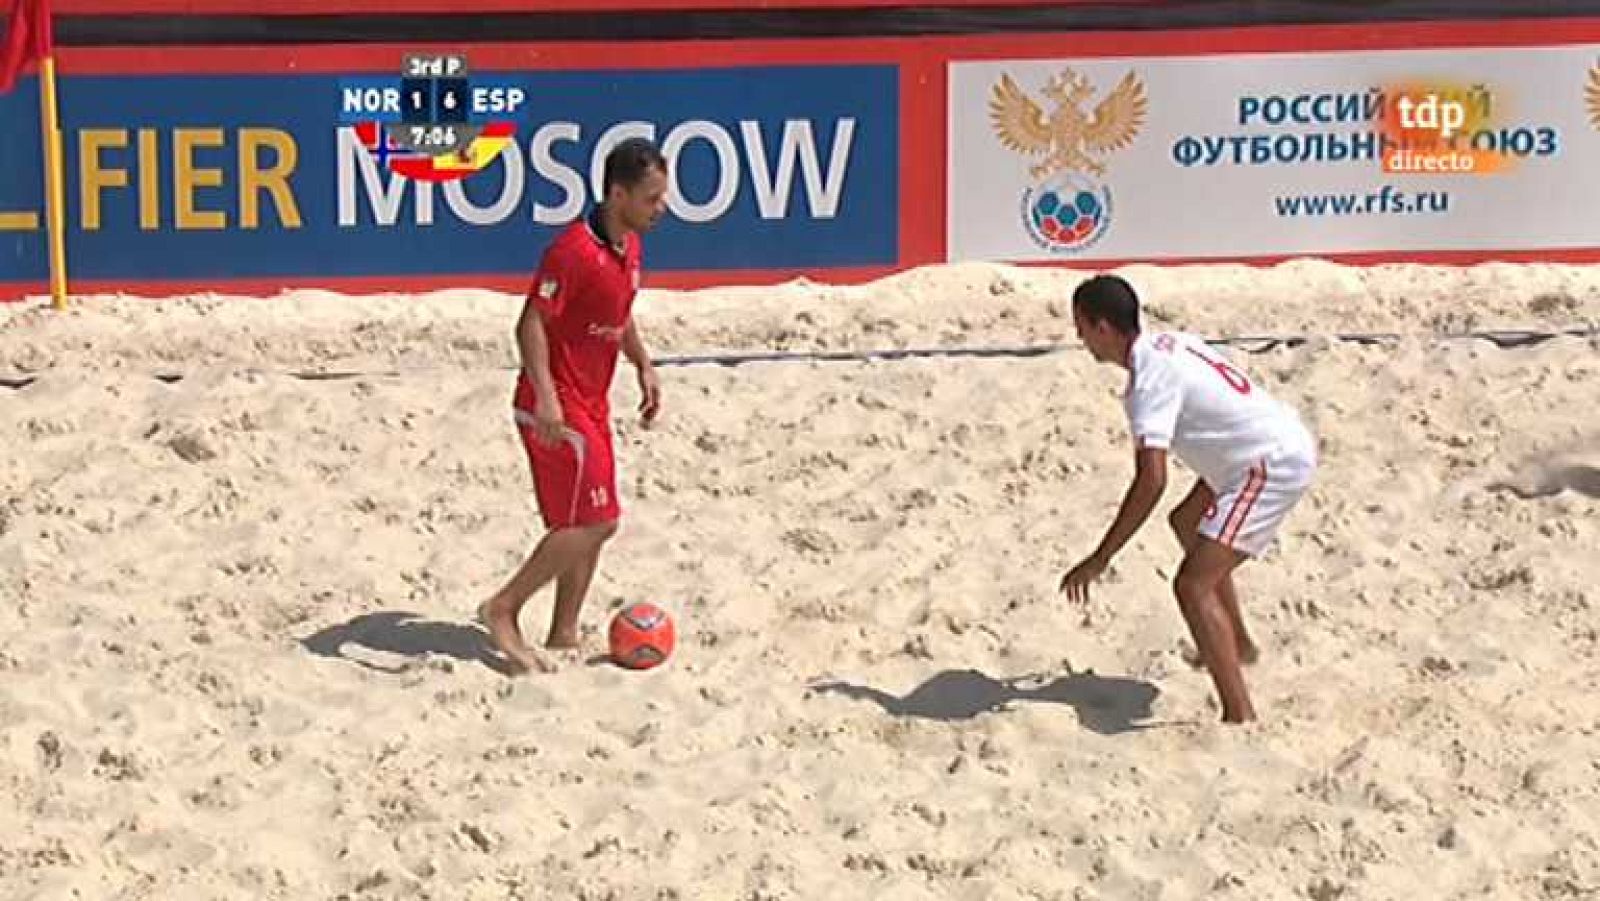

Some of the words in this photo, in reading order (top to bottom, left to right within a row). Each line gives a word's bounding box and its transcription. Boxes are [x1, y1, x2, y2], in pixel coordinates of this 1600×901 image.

[1238, 84, 1491, 126] РОССИЙЙ
[0, 128, 302, 229] FIER
[1275, 186, 1448, 216] www.rfs.ru
[1186, 346, 1251, 395] 6
